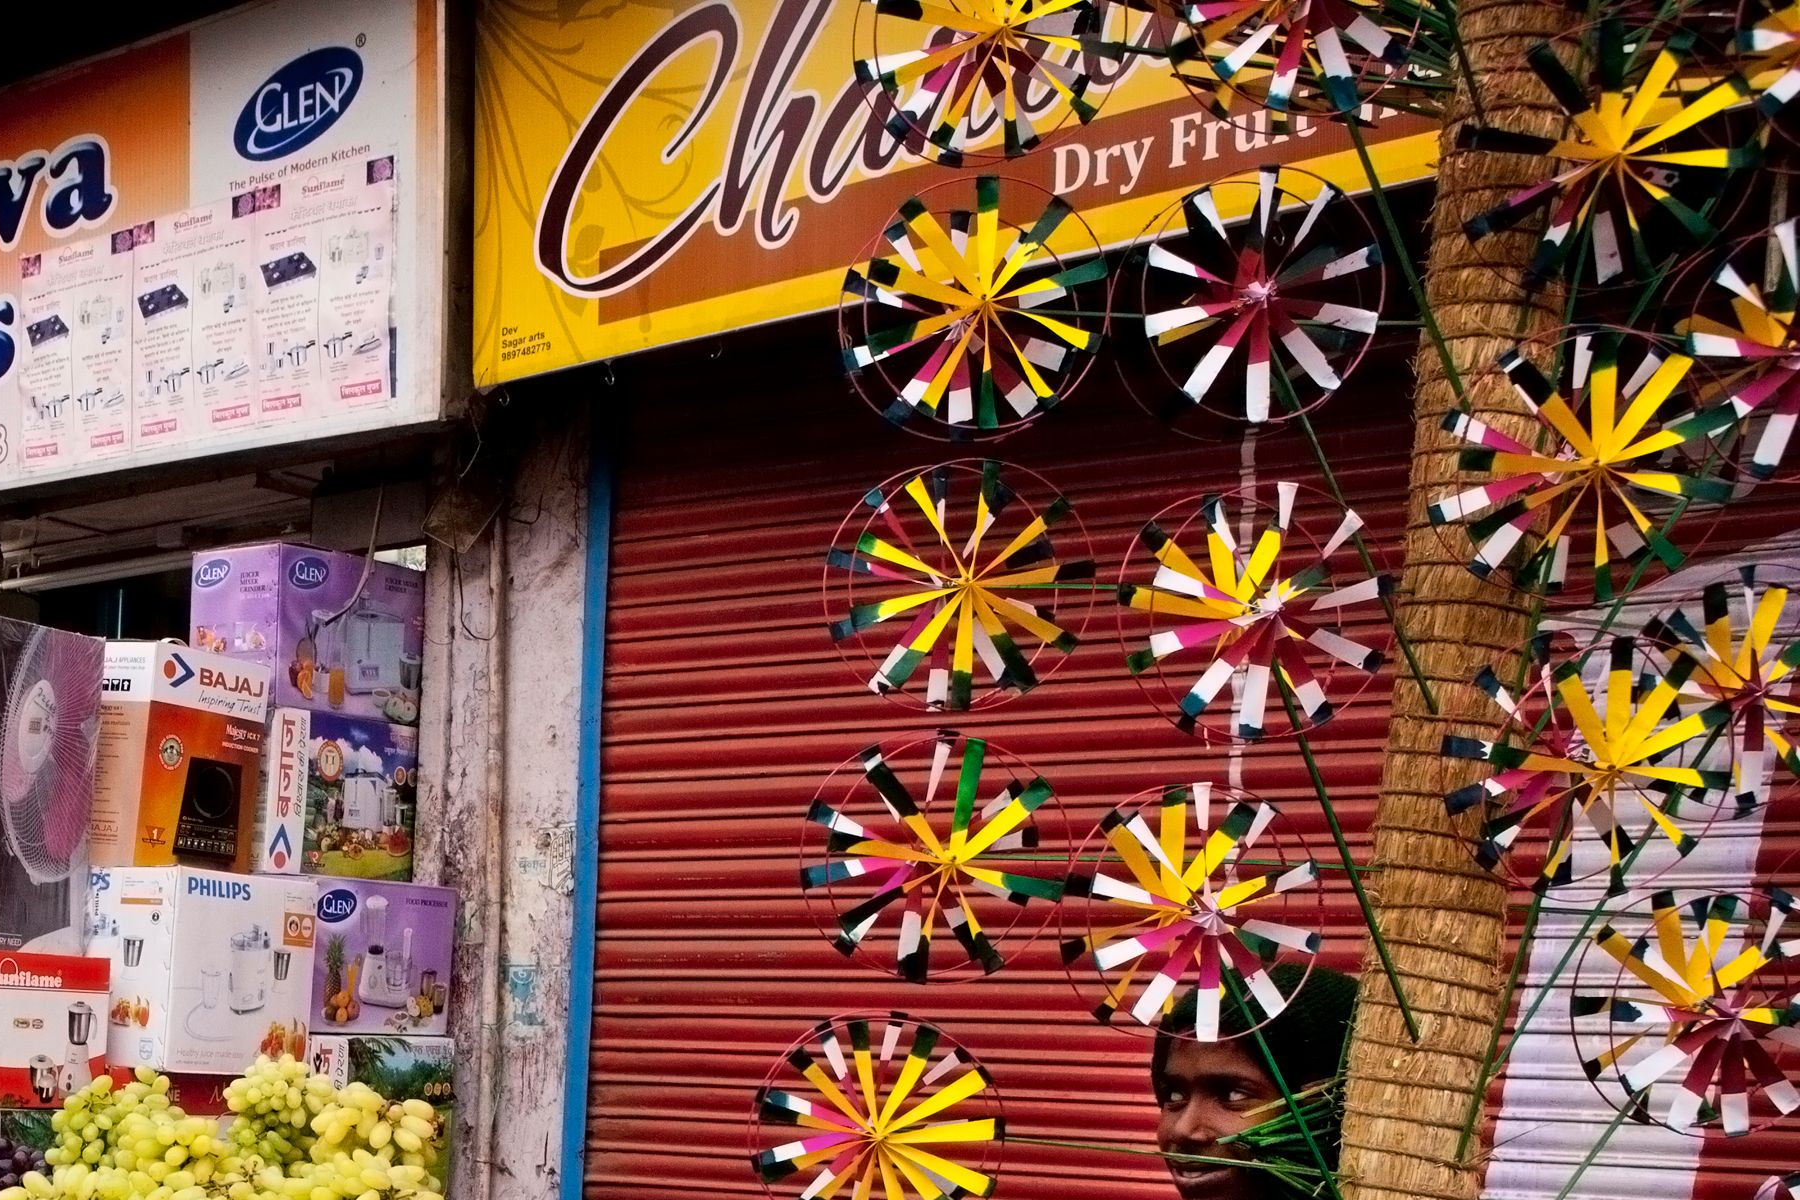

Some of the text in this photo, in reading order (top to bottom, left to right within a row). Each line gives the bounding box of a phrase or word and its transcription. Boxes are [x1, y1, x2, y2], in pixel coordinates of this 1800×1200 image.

[255, 75, 344, 132] GLEN
[229, 142, 371, 193] The Pulse of Modern Kitchen
[1052, 136, 1155, 195] Dry
[501, 326, 518, 336] Dev
[502, 331, 545, 349] Sagar arts
[501, 341, 551, 361] 9897482779
[200, 564, 226, 581] GLEN
[295, 561, 325, 582] GLEN
[199, 667, 265, 698] BAJAJ
[198, 689, 262, 716] Inspiring Trust
[277, 714, 296, 818] बजाज
[187, 876, 252, 901] PHILIPS
[322, 895, 351, 914] GLEN
[8, 936, 22, 947] NEED
